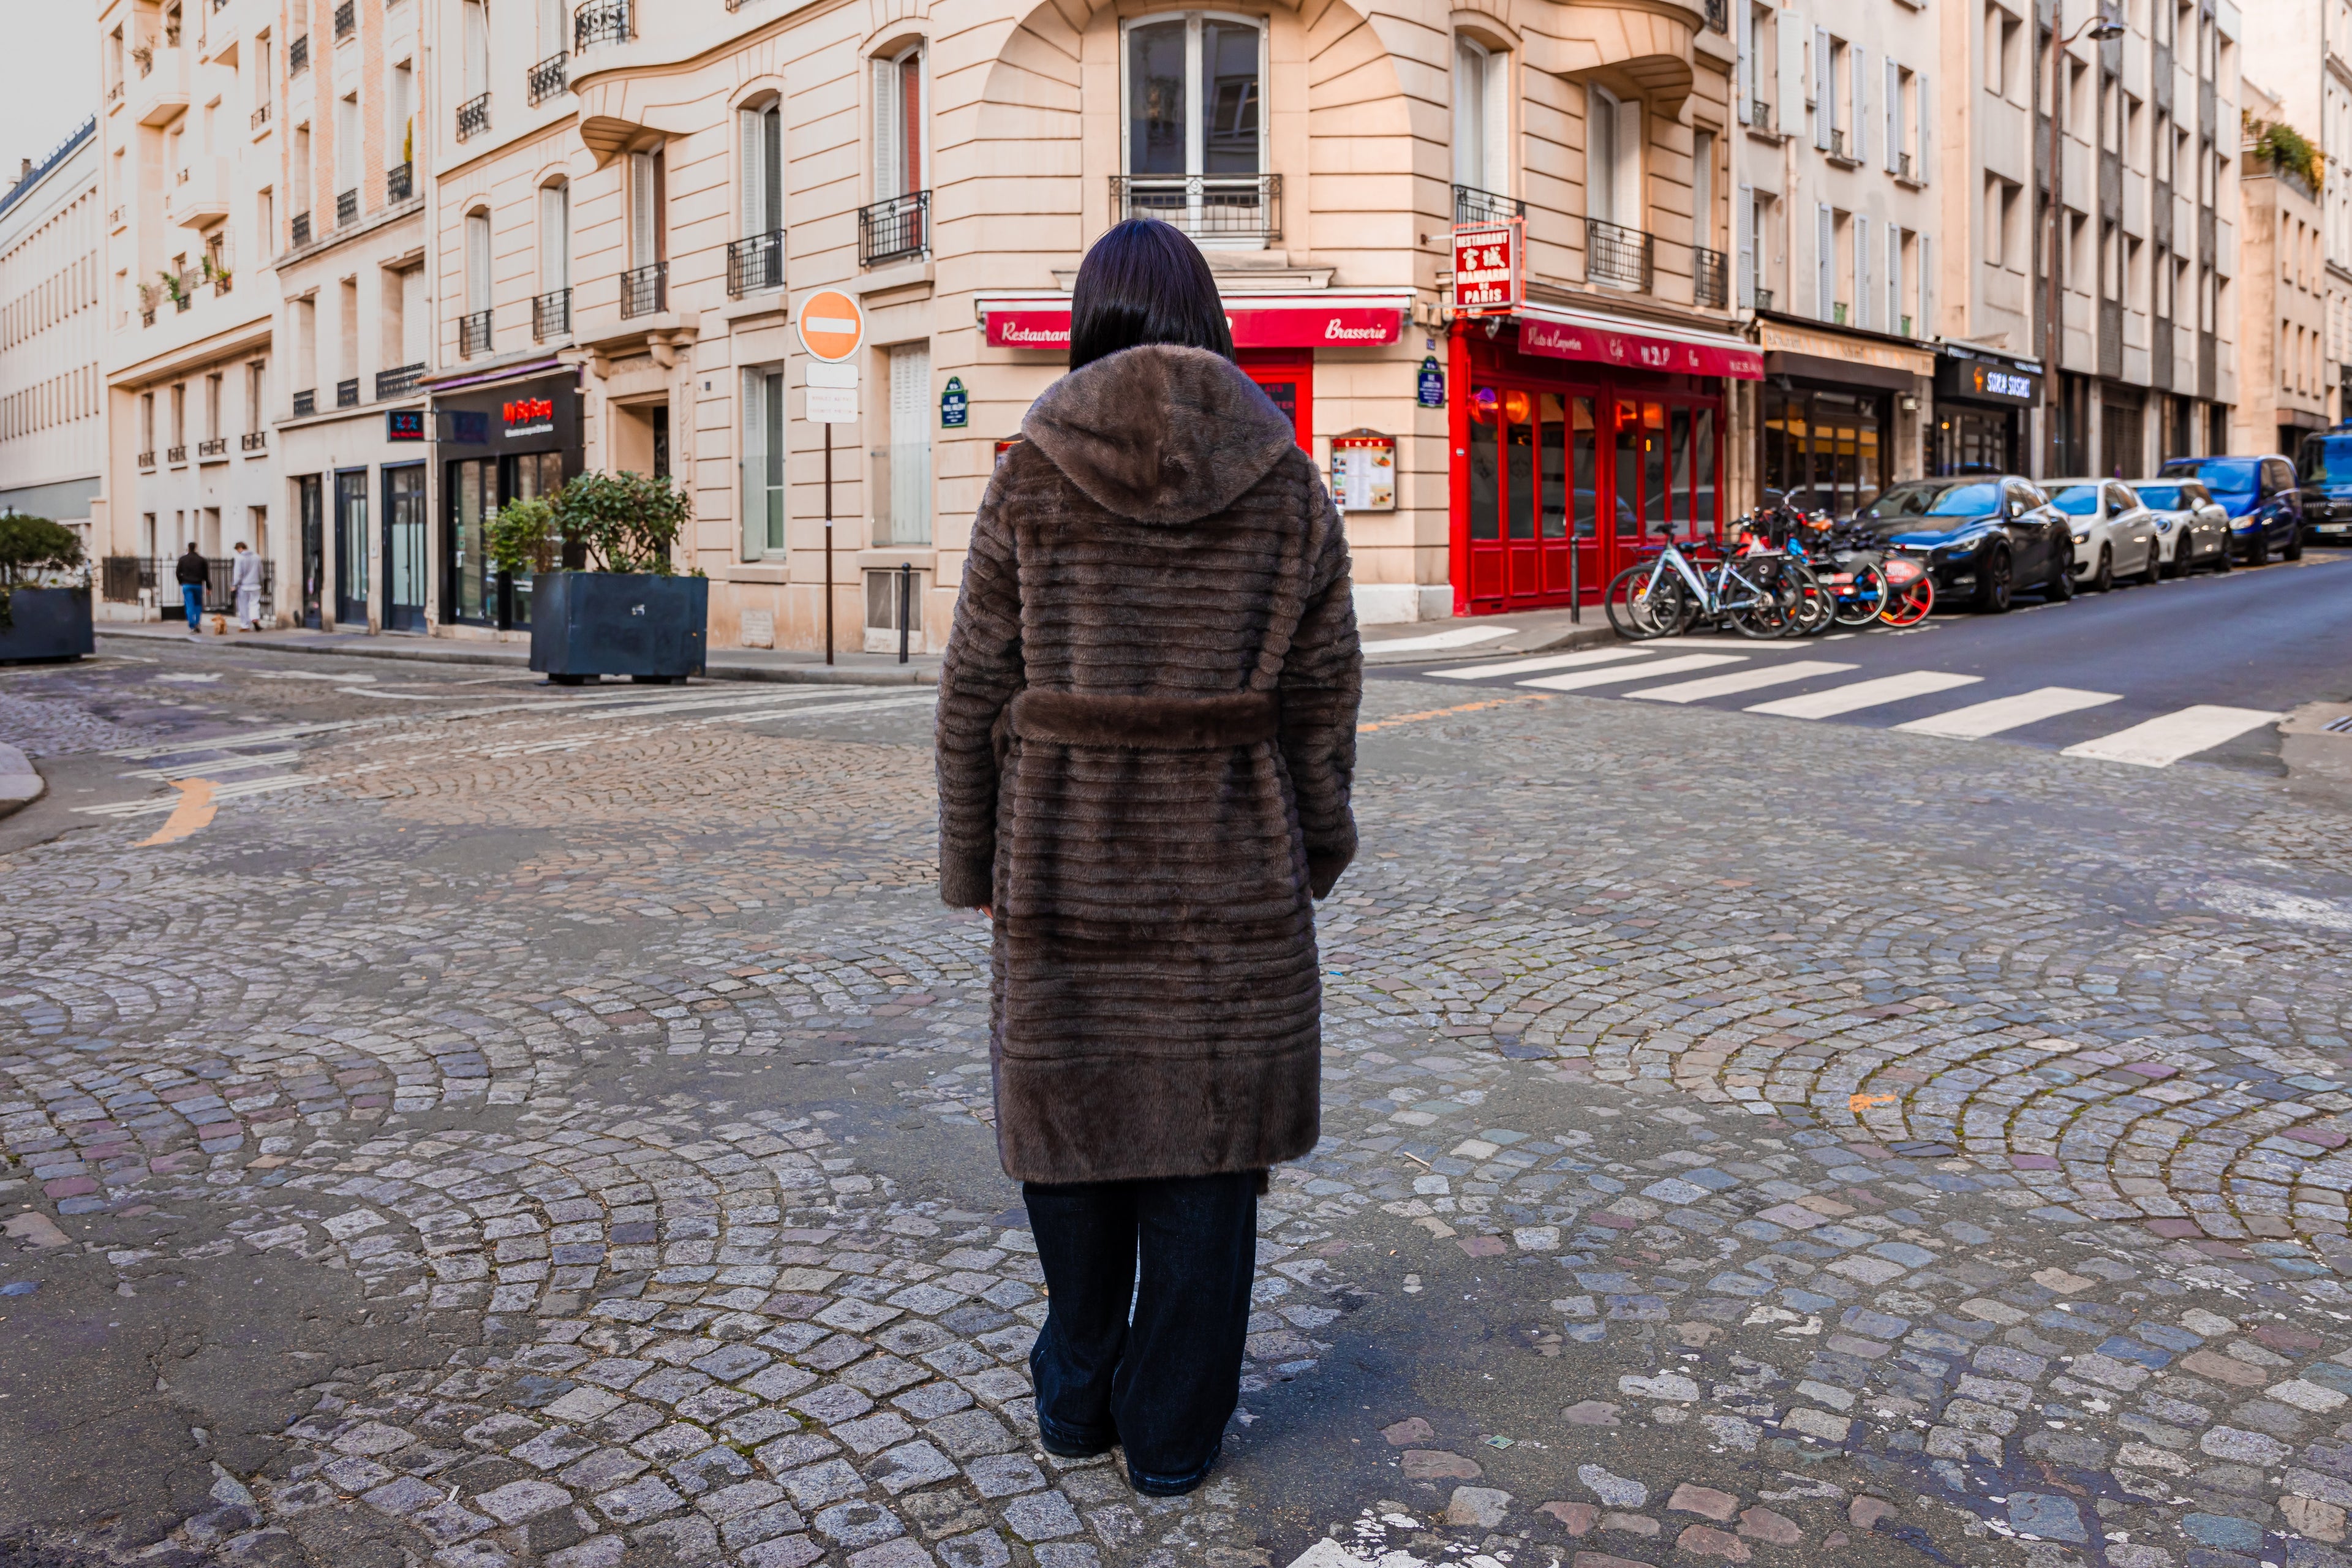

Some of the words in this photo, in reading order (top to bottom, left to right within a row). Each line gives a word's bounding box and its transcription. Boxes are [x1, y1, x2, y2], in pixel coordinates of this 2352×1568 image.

[1457, 232, 1508, 248] RESTAURANT
[1457, 268, 1510, 284] MANDARIN
[1464, 288, 1502, 304] PARIS
[1325, 318, 1387, 339] Brasserie
